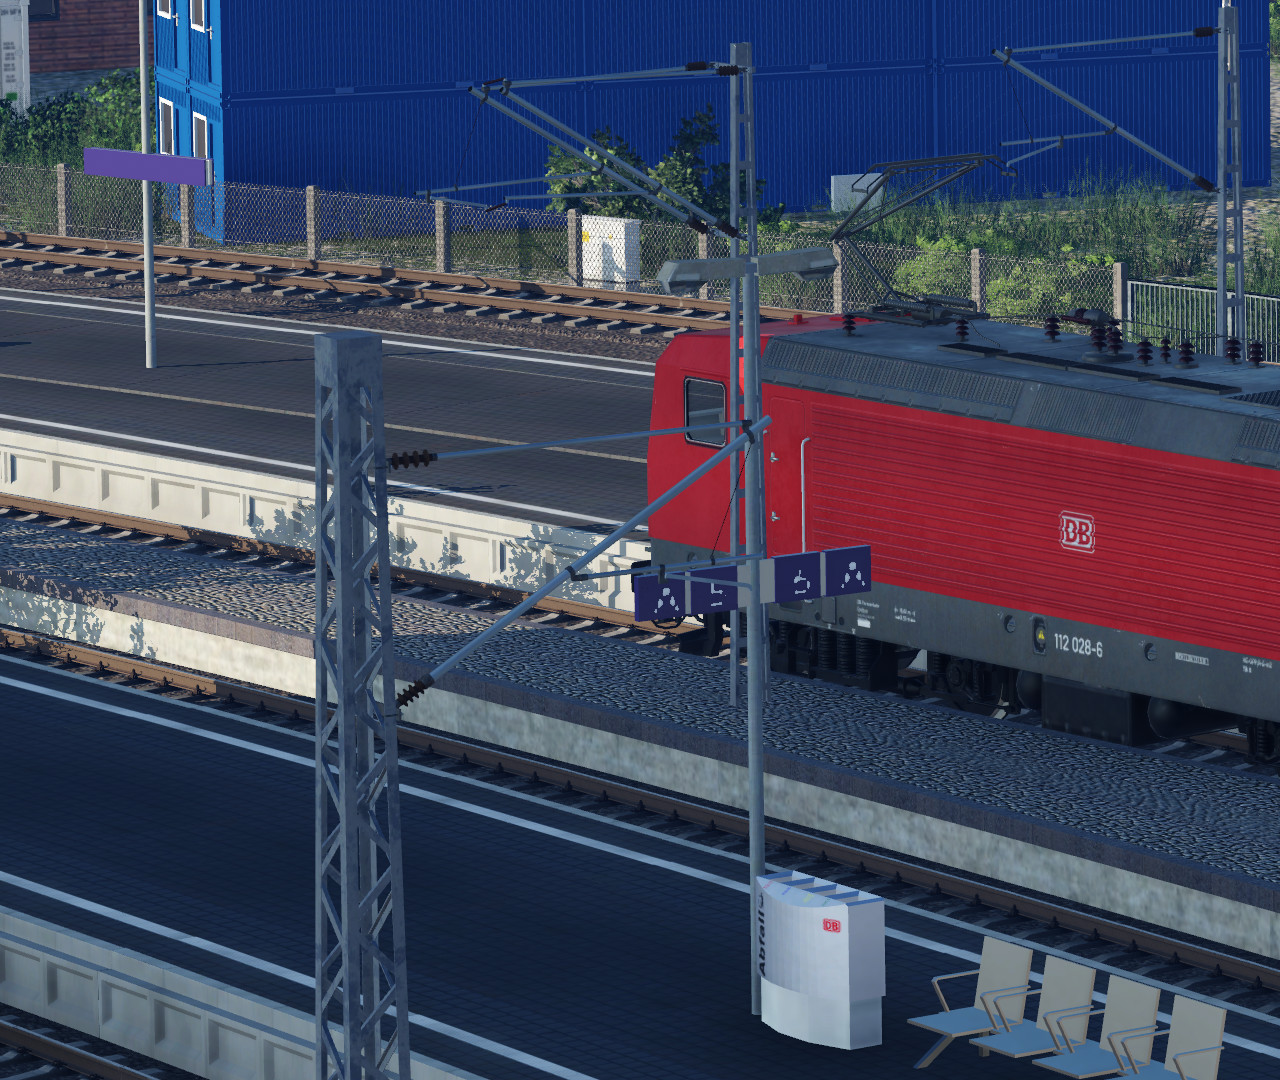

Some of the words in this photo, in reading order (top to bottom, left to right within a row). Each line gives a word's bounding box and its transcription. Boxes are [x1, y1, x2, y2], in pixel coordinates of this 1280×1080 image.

[1062, 515, 1092, 548] DB
[1054, 633, 1069, 651] 112
[1071, 636, 1103, 658] 028-6
[823, 918, 841, 933] DB
